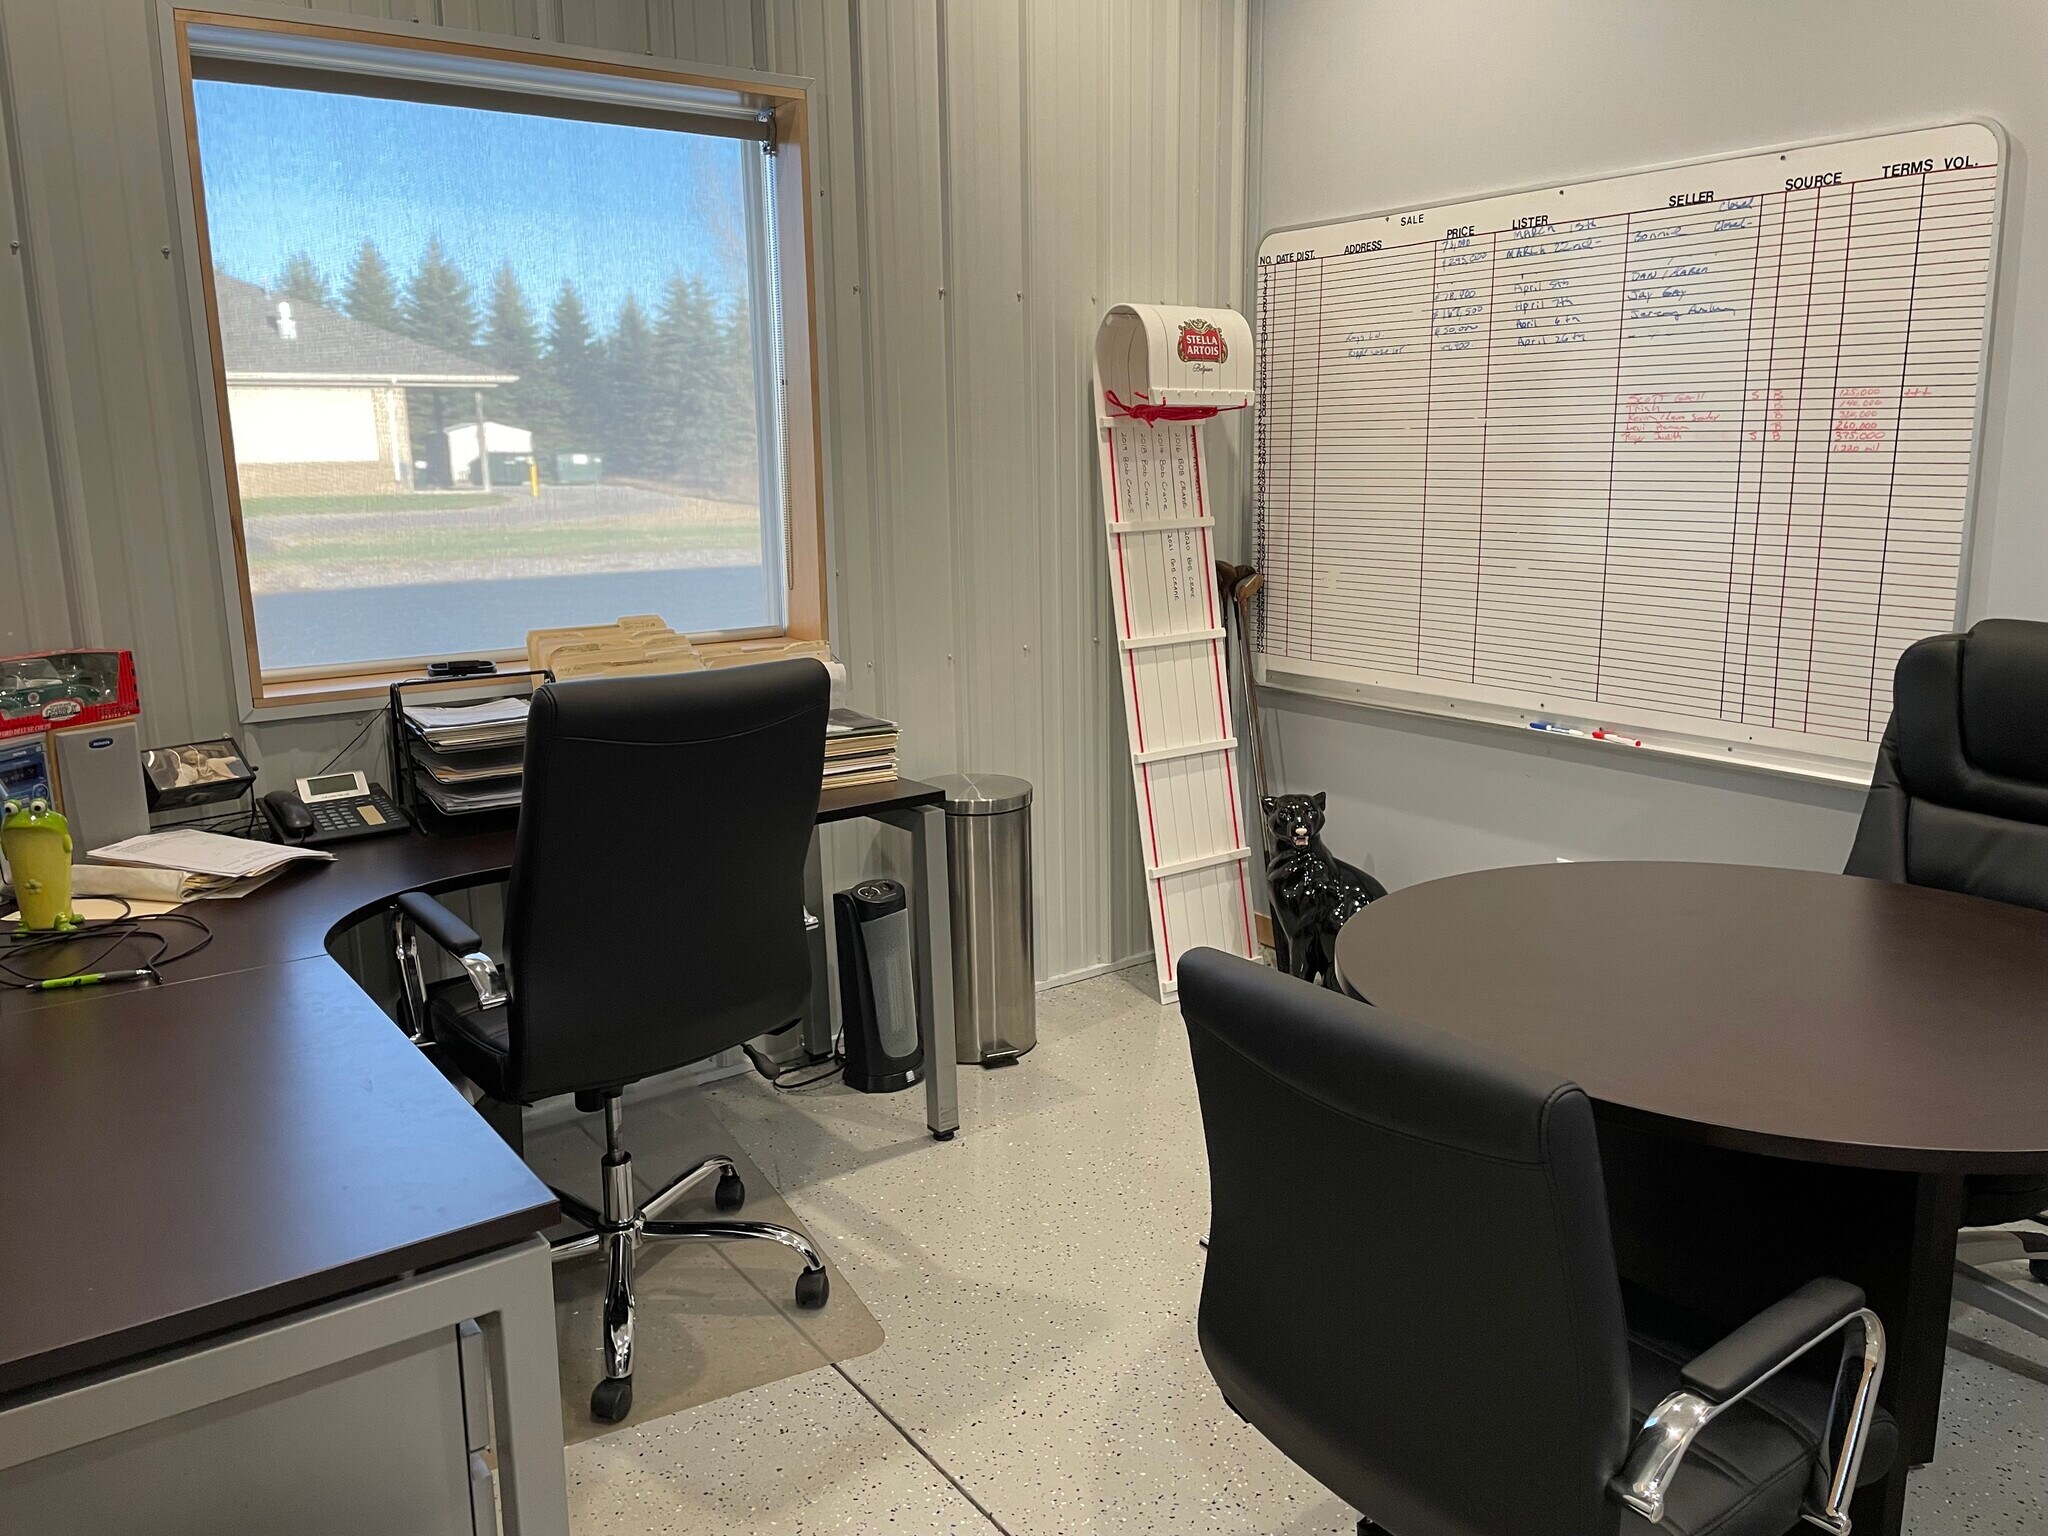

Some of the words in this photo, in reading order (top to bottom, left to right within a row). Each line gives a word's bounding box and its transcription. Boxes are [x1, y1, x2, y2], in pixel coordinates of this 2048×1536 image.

[1882, 159, 1933, 178] TERMS
[1944, 156, 1979, 170] VOL.
[1785, 172, 1842, 191] SOURCE
[1668, 191, 1714, 207] SELLER
[1400, 214, 1425, 226] SALE
[1512, 215, 1549, 230] LISTER
[1446, 225, 1475, 239] PRICE
[1344, 240, 1383, 255] ADDRESS
[1276, 252, 1294, 264] DATE
[1186, 335, 1218, 345] STELLA
[1187, 345, 1219, 356] ARTOIS
